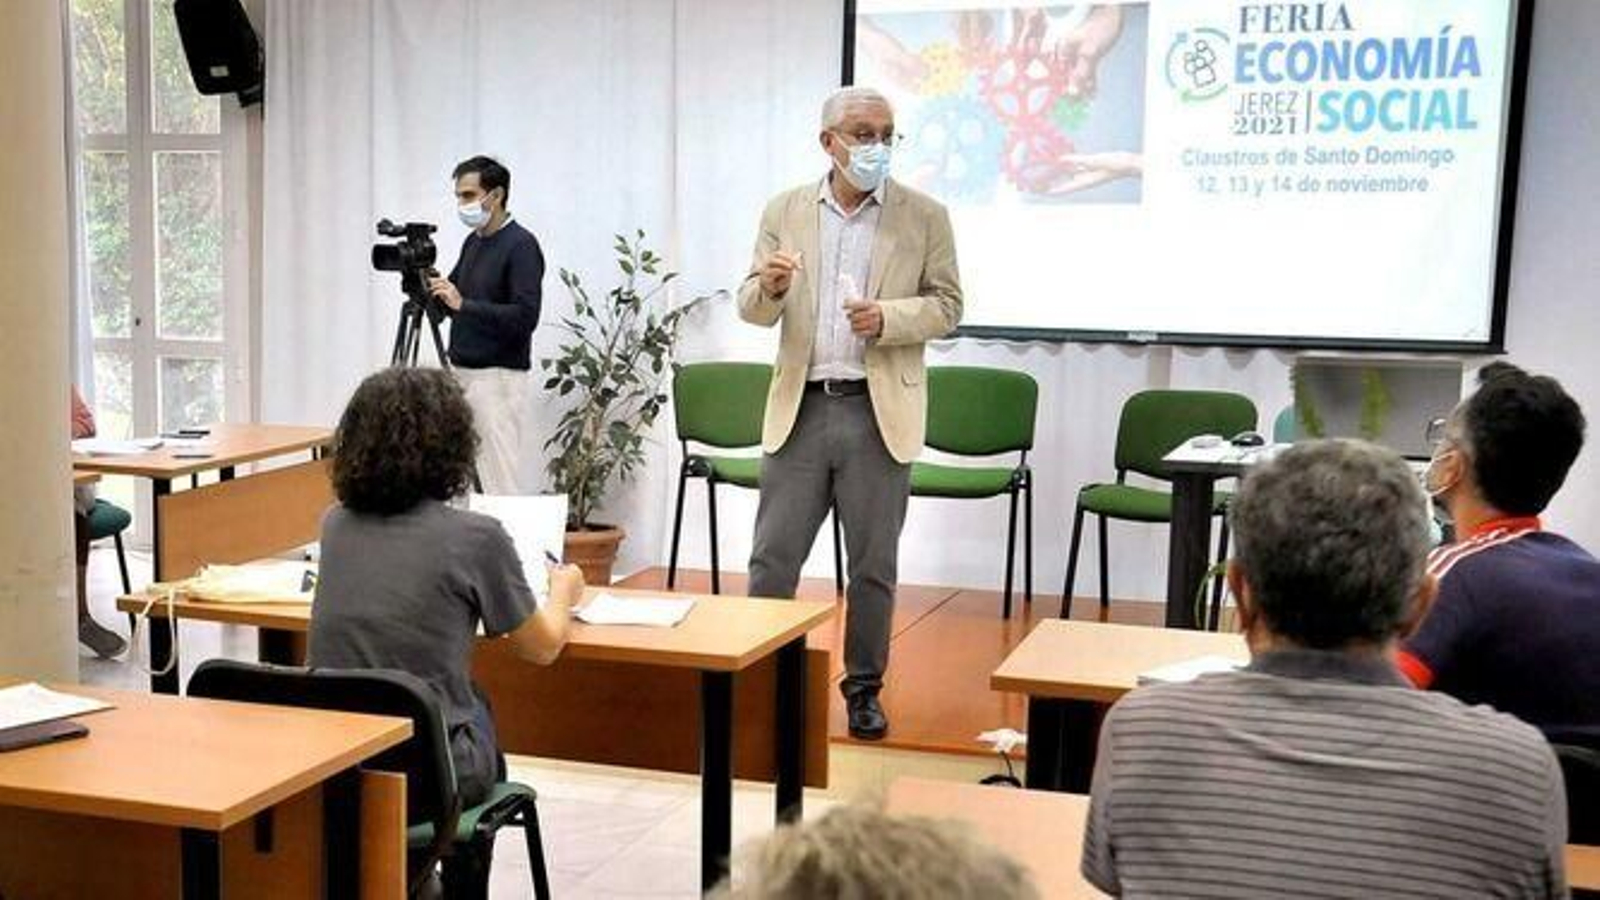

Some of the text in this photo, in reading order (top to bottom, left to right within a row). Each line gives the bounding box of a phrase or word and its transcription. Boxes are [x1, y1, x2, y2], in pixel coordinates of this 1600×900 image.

[1239, 2, 1354, 33] FERIA
[1234, 25, 1481, 84] ECONOMÍA
[1234, 92, 1298, 115] JEREZ
[1316, 89, 1478, 132] SOCIAL
[1233, 117, 1298, 135] 2021
[1182, 146, 1455, 168] Claustros de Santo Domingo
[1229, 177, 1248, 193] 13
[1254, 180, 1265, 196] y
[1272, 176, 1292, 192] 14
[1297, 175, 1321, 192] de
[1327, 174, 1429, 193] noviembre
